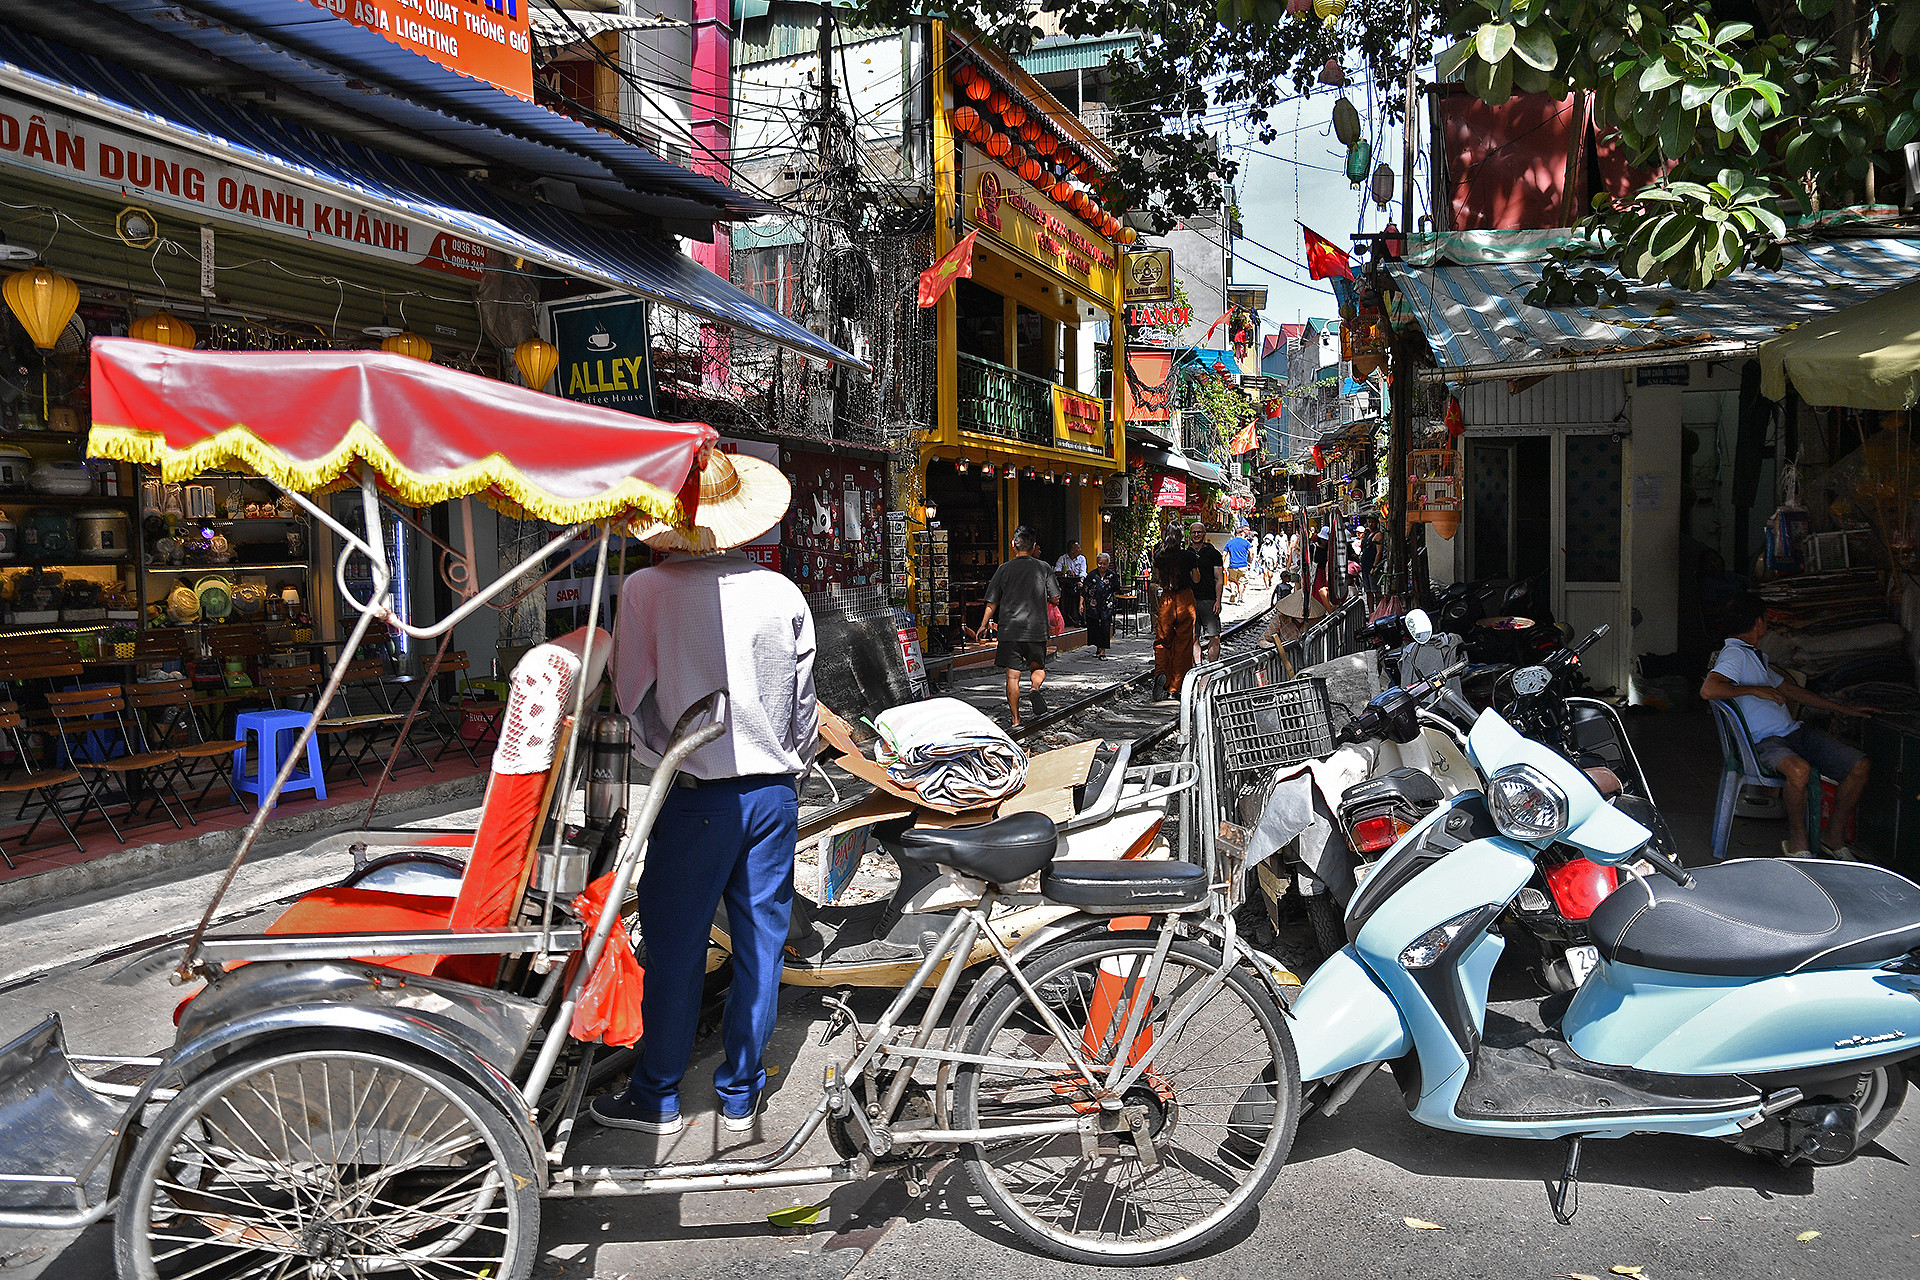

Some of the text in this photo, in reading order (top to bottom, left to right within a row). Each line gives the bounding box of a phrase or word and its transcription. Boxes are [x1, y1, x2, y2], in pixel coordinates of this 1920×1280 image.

[354, 0, 390, 32] ASIA
[396, 15, 459, 58] LIGHTING
[463, 10, 506, 45] THÔNG
[510, 29, 529, 54] GIÓ
[0, 113, 86, 172] DÂN
[217, 177, 304, 228] OANH
[313, 208, 409, 252] KHÁNH
[452, 239, 485, 258] 0936 534
[568, 356, 643, 395] ALLEY
[574, 394, 644, 405] Coffee House
[556, 588, 580, 602] SAPA
[1351, 781, 1385, 795] HONDA
